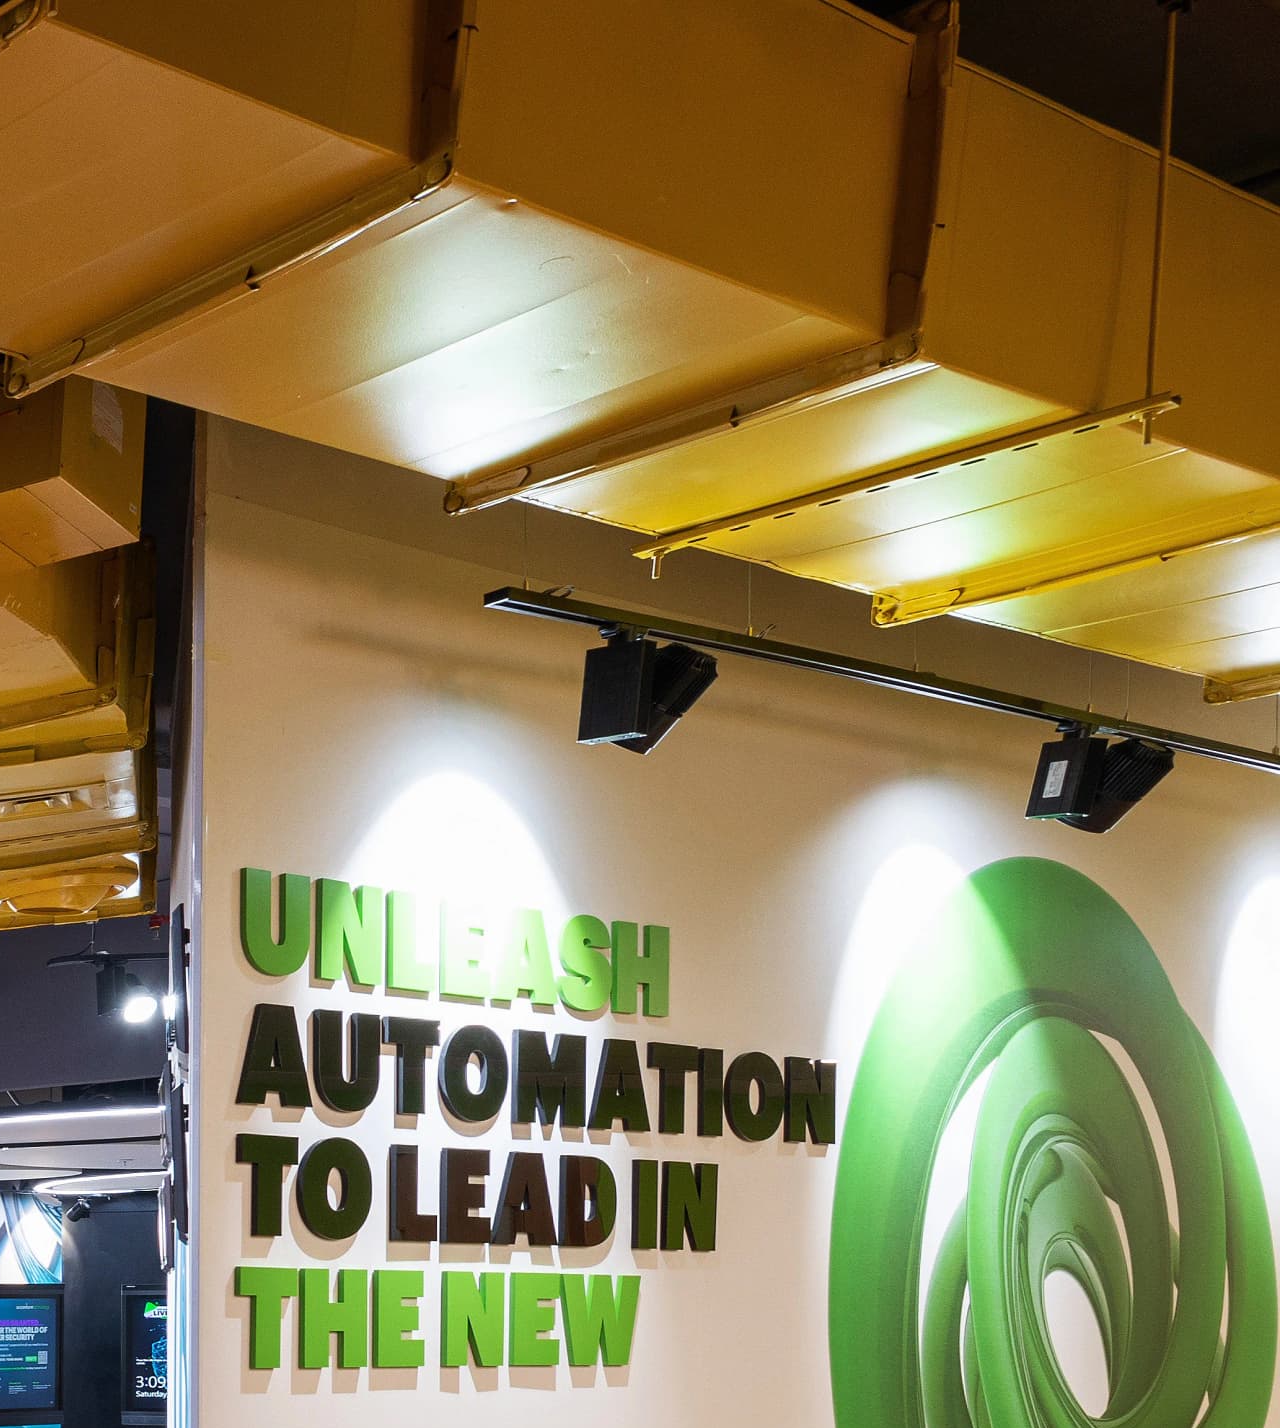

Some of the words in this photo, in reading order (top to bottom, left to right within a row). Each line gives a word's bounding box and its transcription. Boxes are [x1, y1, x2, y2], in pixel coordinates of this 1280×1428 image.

[240, 867, 671, 1018] UNLEASH
[235, 1003, 837, 1145] AUTOMATION
[235, 1133, 373, 1241] TO
[389, 1144, 618, 1247] LEAD
[631, 1159, 719, 1252] IN
[5, 1333, 35, 1341] SECURITY
[39, 1326, 48, 1334] OF
[234, 1266, 425, 1370] THE
[440, 1270, 642, 1368] NEW
[135, 1375, 167, 1389] 3:09
